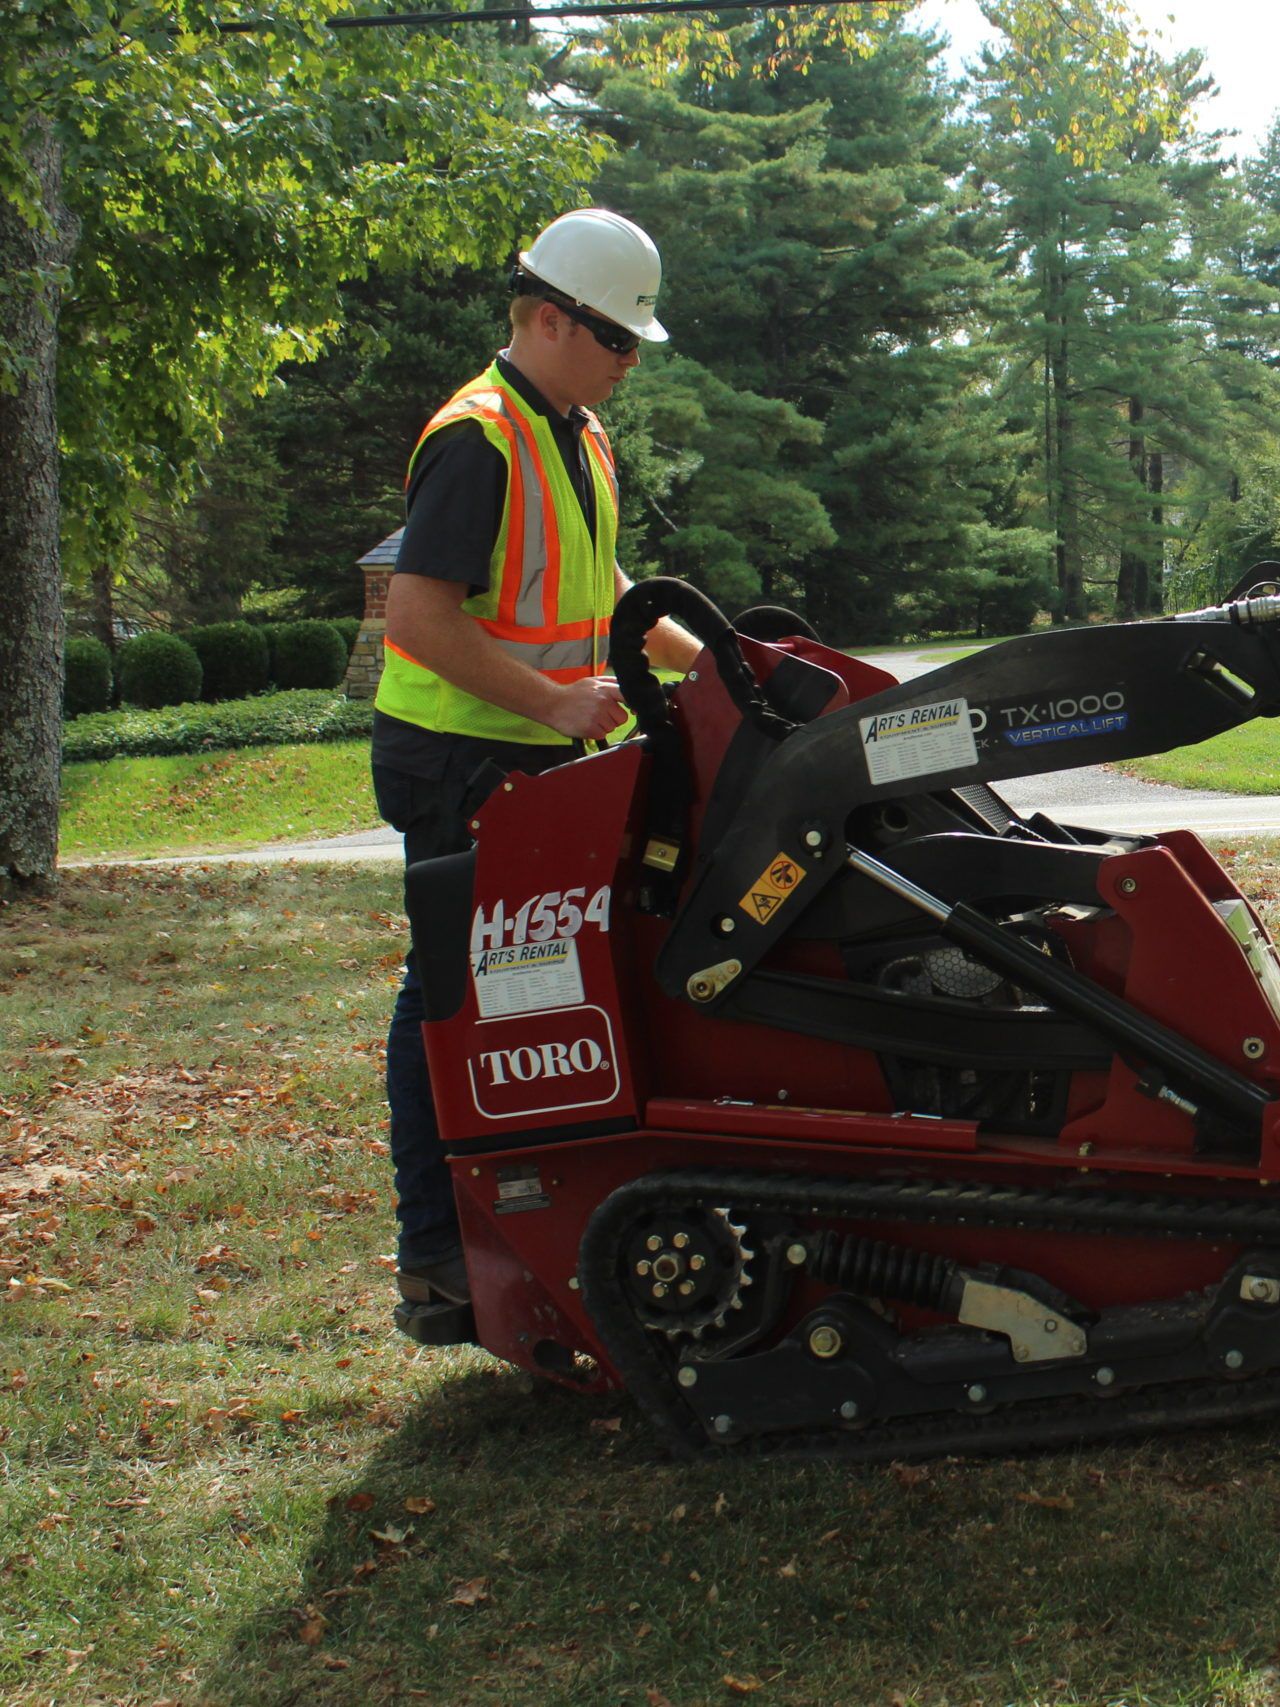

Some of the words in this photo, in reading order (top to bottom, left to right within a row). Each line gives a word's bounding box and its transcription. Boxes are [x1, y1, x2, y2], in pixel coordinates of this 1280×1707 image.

[865, 713, 906, 744] ART'S
[910, 702, 960, 725] RENTAL
[1009, 723, 1089, 744] VERTICAL
[1091, 715, 1126, 731] LIFT
[470, 884, 611, 951] H-1554
[475, 949, 515, 977] ART'S
[519, 941, 568, 961] RENTAL
[479, 1038, 602, 1086] TORO
